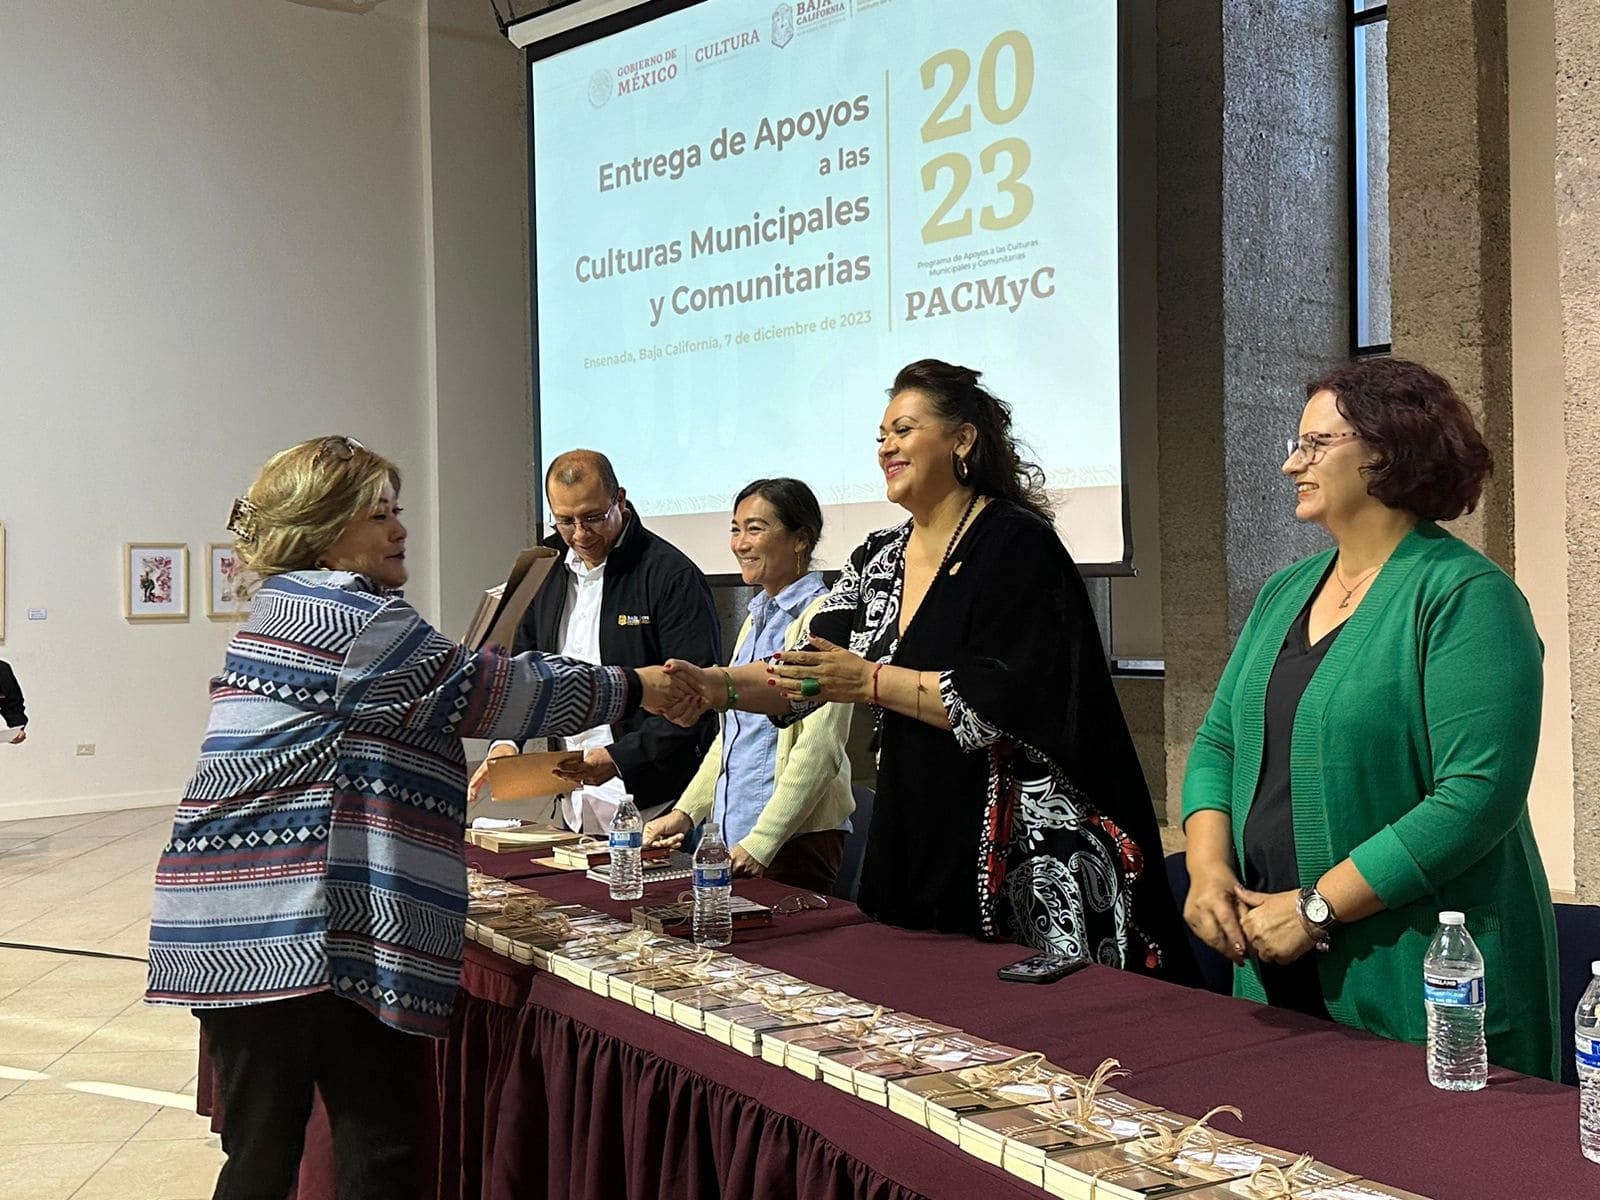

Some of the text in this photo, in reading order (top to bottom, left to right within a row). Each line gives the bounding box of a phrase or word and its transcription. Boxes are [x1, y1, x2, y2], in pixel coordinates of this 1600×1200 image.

[796, 3, 845, 26] CALIFORNIA
[617, 48, 678, 77] GOBIERNO DE
[695, 29, 760, 63] CULTURA
[618, 63, 678, 96] MÉXICO
[920, 29, 1035, 144] 20
[599, 95, 869, 192] Entrega de Apoyos
[819, 147, 870, 176] a las
[920, 137, 1034, 245] 23
[576, 196, 870, 283] Culturas Municipales
[917, 256, 951, 269] Programa
[953, 253, 962, 262] de
[964, 250, 989, 260] Apoyos
[996, 245, 1006, 253] las
[1007, 240, 1039, 251] Culturas
[929, 262, 972, 276] Municipales
[977, 252, 1026, 267] Comunitarias
[649, 252, 871, 327] y Comunitarias
[905, 266, 1055, 321] PACMyC
[584, 310, 872, 369] Ensenada, Baja California, 7 de diciembre de 2023
